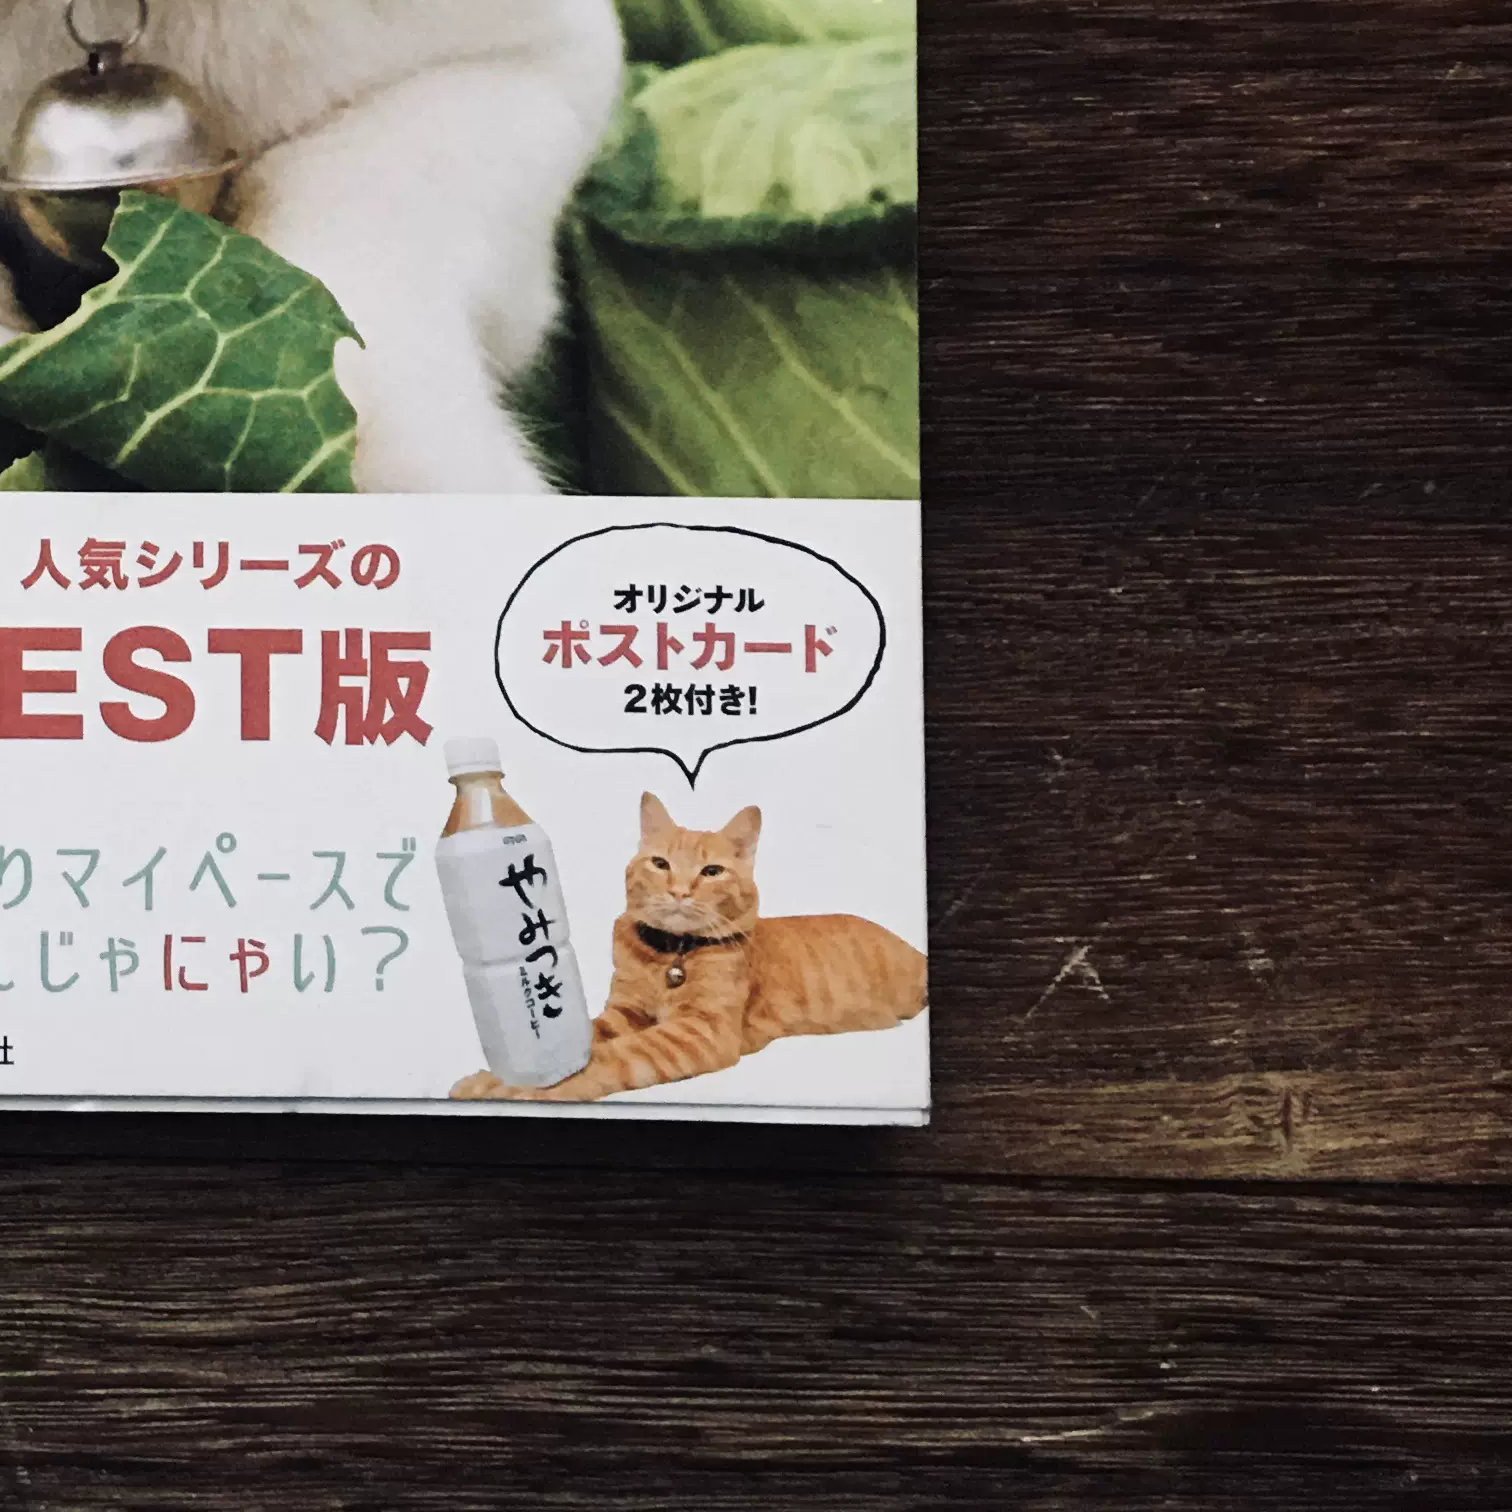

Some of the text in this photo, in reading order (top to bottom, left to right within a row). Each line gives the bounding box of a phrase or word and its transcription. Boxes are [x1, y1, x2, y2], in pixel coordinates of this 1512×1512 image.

[614, 584, 764, 614] オリジナル
[543, 620, 837, 673] ポストカード
[624, 683, 757, 715] 2枚付き!
[498, 853, 564, 1019] やみつき
